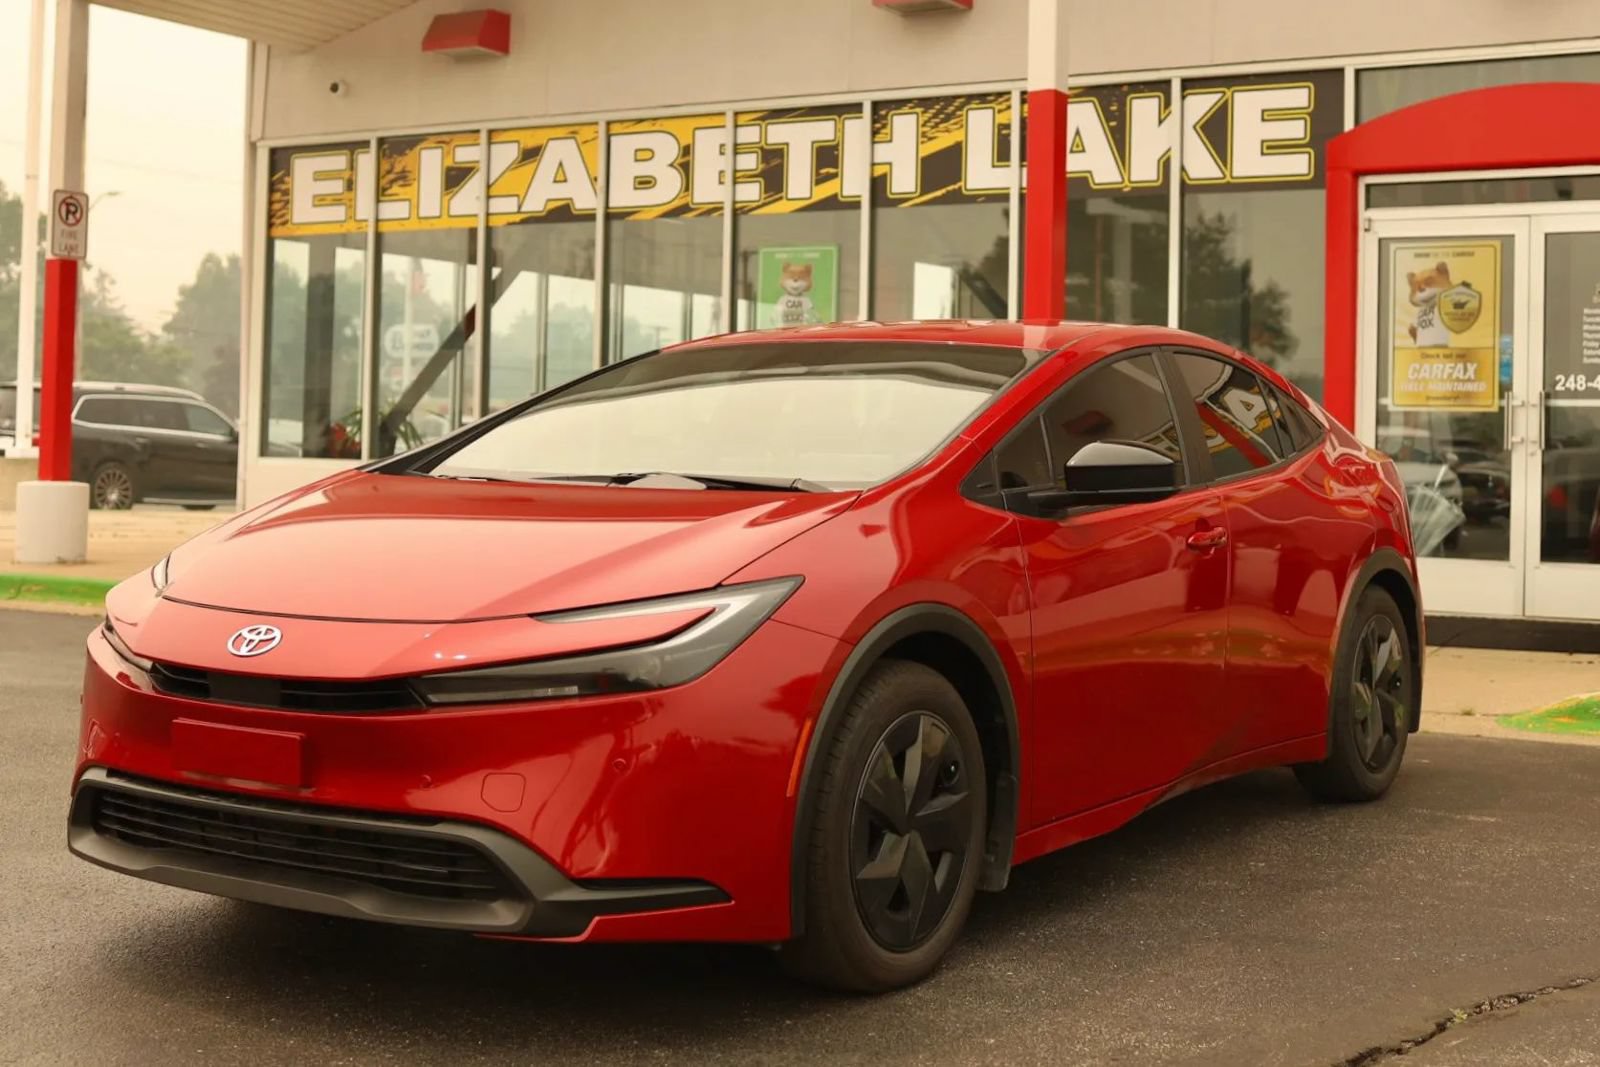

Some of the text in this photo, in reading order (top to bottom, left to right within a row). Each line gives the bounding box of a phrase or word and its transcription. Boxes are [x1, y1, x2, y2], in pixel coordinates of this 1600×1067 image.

[290, 84, 1314, 224] ELIZABETH LAKE
[1407, 362, 1477, 380] CARFAX
